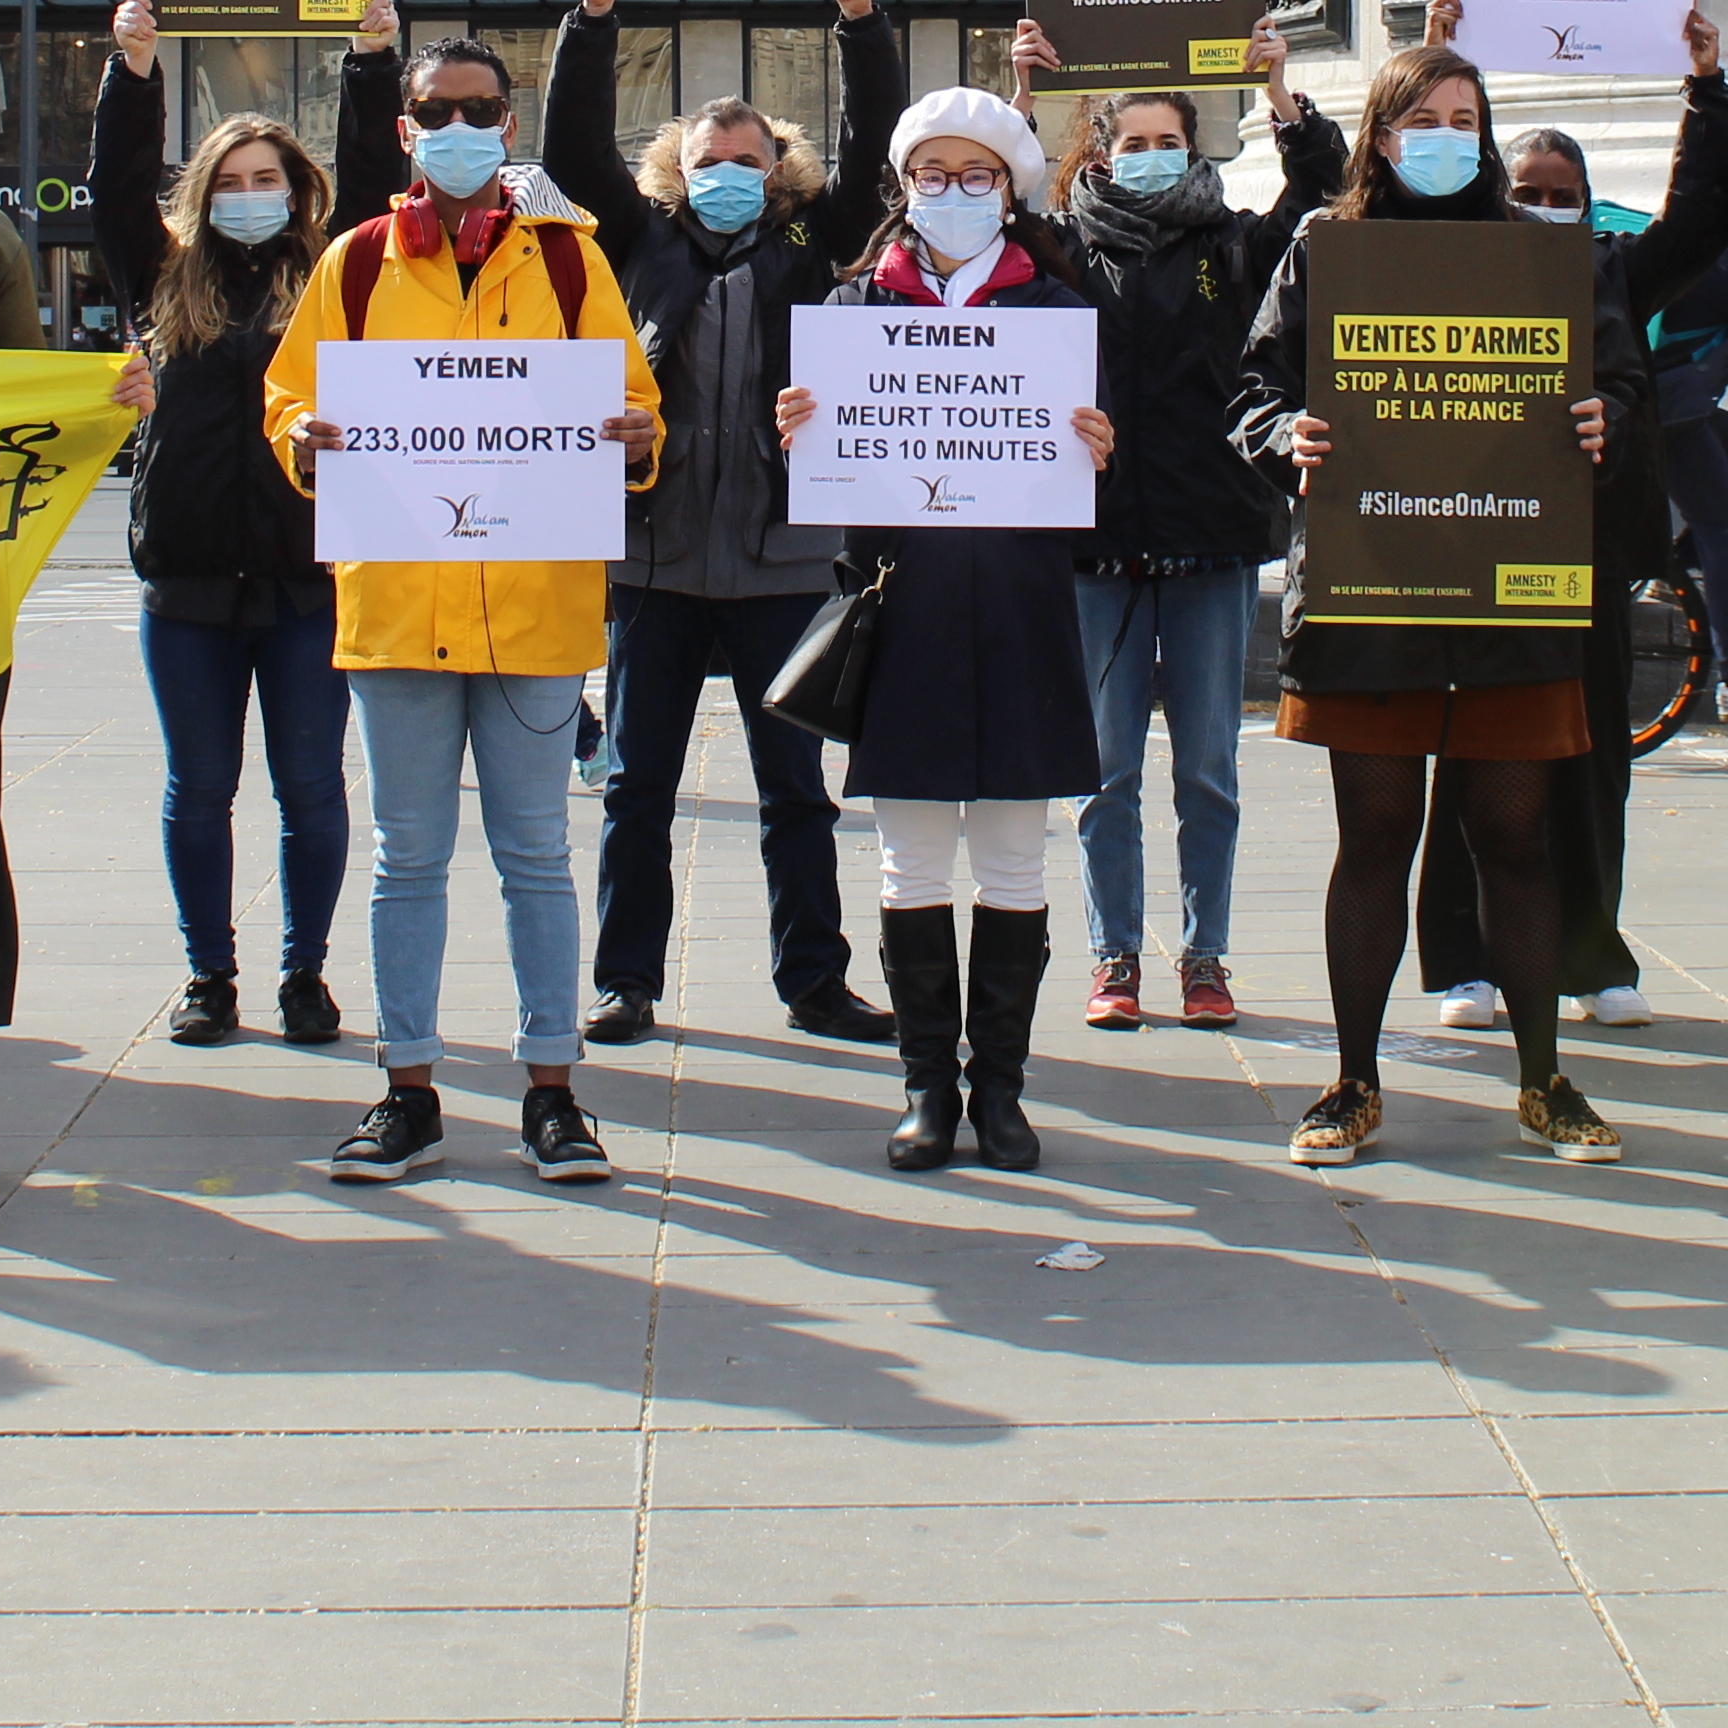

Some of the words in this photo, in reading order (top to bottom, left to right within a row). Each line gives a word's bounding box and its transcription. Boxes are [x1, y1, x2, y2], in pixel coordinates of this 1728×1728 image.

[1196, 47, 1239, 58] AMNESTY
[881, 319, 994, 347] YÉMEN
[1339, 324, 1436, 353] VENTES
[1446, 325, 1560, 356] D'ARMES
[413, 351, 527, 378] YÉMEN
[869, 373, 905, 393] UN
[916, 373, 1025, 395] ENFANT
[1334, 370, 1388, 391] STOP
[1393, 367, 1408, 392] À
[1414, 372, 1438, 392] LA
[1444, 369, 1565, 394] COMPLICITÉ
[837, 405, 932, 427] MEURT
[941, 406, 1050, 428] TOUTES
[1376, 399, 1402, 419] DE
[1409, 399, 1435, 419] LA
[1442, 400, 1524, 421] FRANCE
[345, 426, 464, 456] 233,000
[477, 426, 596, 451] MORTS
[837, 438, 888, 459] LES
[898, 439, 926, 460] 10
[936, 439, 1057, 461] MINUTES
[1358, 491, 1540, 517] #SilenceOnArme
[1505, 574, 1555, 587] AMNESTY
